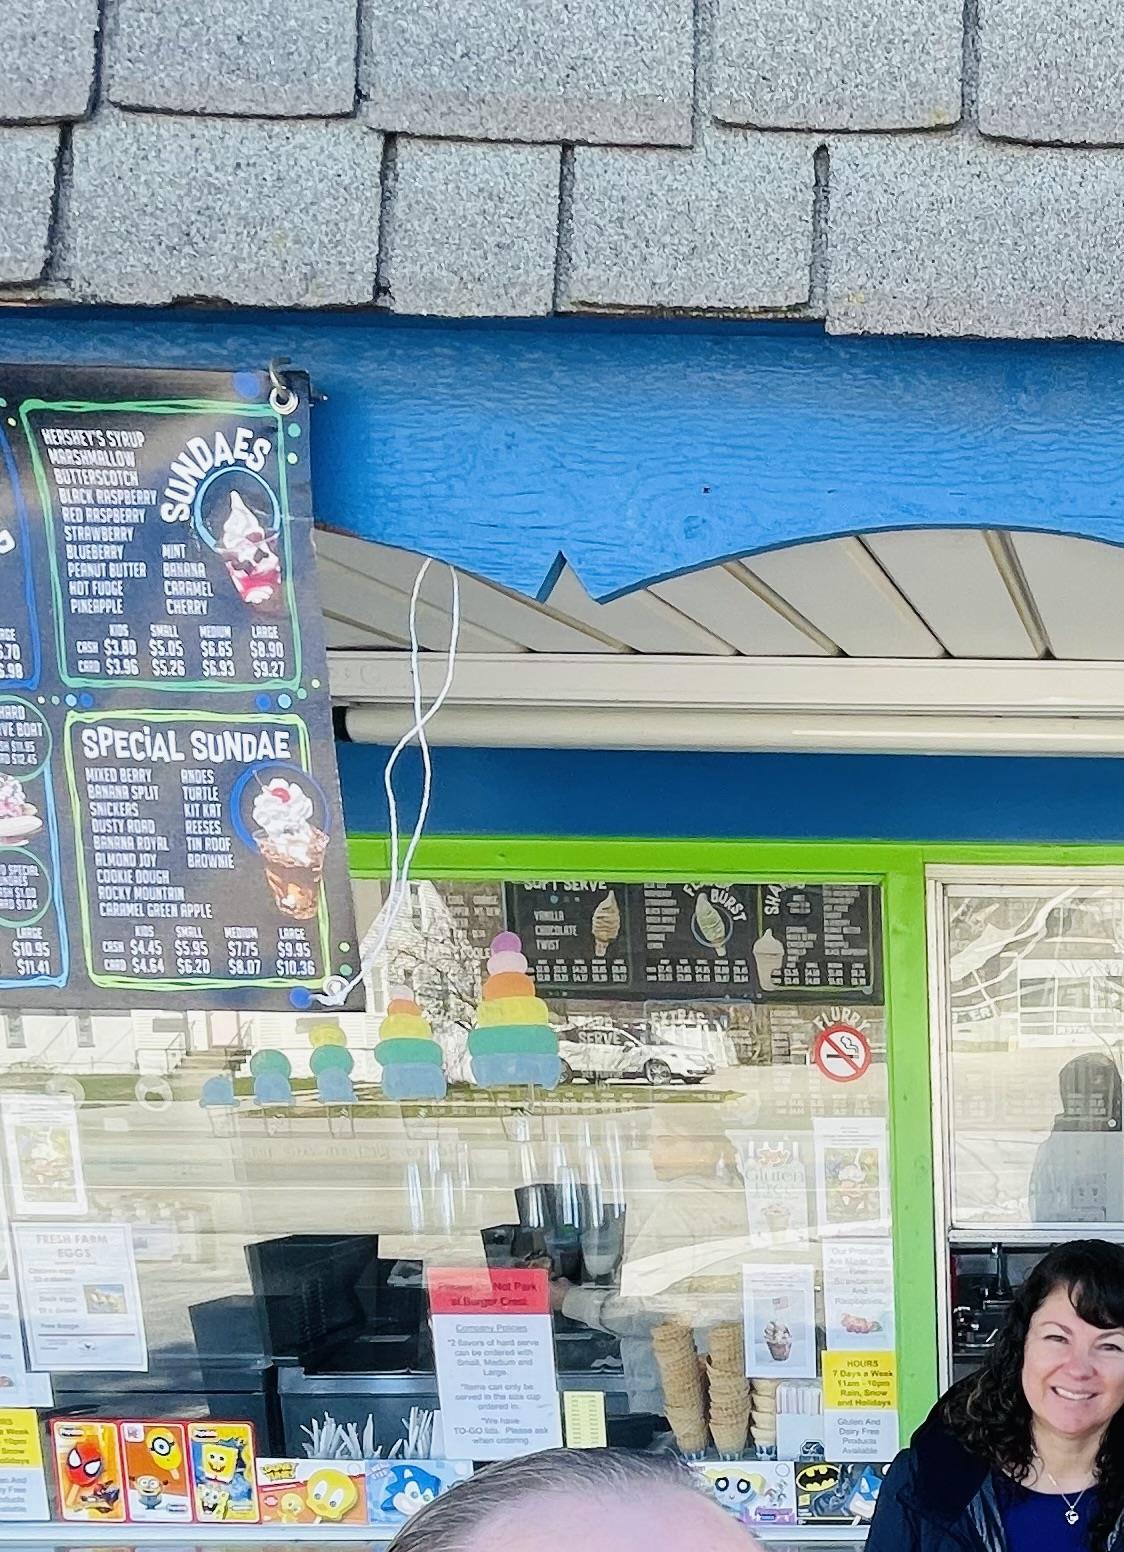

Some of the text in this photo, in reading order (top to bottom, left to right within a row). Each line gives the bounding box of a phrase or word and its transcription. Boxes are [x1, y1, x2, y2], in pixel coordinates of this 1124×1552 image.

[41, 428, 145, 448] HERSHEY'S SYRUP
[48, 448, 135, 467] MARSHMALLOW
[54, 468, 139, 486] BUTTERSCOTCH
[160, 427, 272, 523] SUNDAES
[59, 488, 157, 506] BLACK RASPBERRY
[61, 506, 145, 524] RED RASPBERRY
[64, 526, 134, 542] STRAWBERRY
[66, 544, 125, 560] BLUEBERRY
[162, 543, 186, 559] MINT
[68, 562, 147, 578] PEANUT BUTTER
[163, 562, 206, 578] BANANA
[69, 580, 124, 596] HOT FUDGE
[164, 580, 214, 597] CARAMEL
[71, 599, 124, 614] PINEAPPLE
[166, 599, 208, 615] CHERRY
[150, 625, 179, 638] SMALL
[251, 626, 279, 639] LARGE
[149, 639, 184, 657] $5.05
[201, 641, 233, 658] $6.65
[250, 640, 285, 659] $8.90
[105, 658, 140, 676] $3.96
[152, 659, 186, 677] $5.26
[202, 659, 235, 677] $6.93
[253, 660, 285, 678] $9.27
[190, 730, 292, 764] SUNDAE
[85, 767, 153, 783] MIXED BERRY
[181, 769, 215, 784] ANDES
[87, 785, 160, 801] BANANA SPLIT
[182, 786, 219, 801] TURTLE
[89, 803, 140, 818] SNICKERS
[184, 804, 222, 818] KIT KAT
[91, 819, 156, 834] DUSTY ROAD
[185, 820, 222, 835] REESES
[93, 836, 170, 851] BANANA ROYAL
[186, 837, 232, 852] TIN ROOF
[94, 853, 158, 868] ALMOND JOY
[187, 854, 235, 869] BROWNIE
[96, 869, 170, 885] COOKIE DOUGH
[98, 886, 185, 901] ROCKY MOUNTAIN
[99, 902, 214, 919] CARAMEL GREEN APPLE
[175, 926, 204, 939] SMALL
[12, 940, 51, 958] $10.95
[130, 939, 163, 956] $4.45
[175, 940, 209, 957] $5.95
[228, 941, 259, 957] $7.75
[277, 942, 312, 958] $9.95
[16, 958, 51, 976] $11.41
[132, 958, 165, 974] $4.64
[177, 958, 211, 975] $6.20
[228, 959, 261, 976] $8.07
[276, 960, 316, 976] $10.36
[578, 1031, 622, 1045] SERVE
[36, 1234, 71, 1245] FRESH
[58, 1248, 92, 1258] EGGS
[493, 1282, 511, 1291] Not
[514, 1282, 537, 1292] Park
[847, 1360, 879, 1368] HOURS
[840, 1370, 861, 1379] Days
[855, 1400, 891, 1409] Holidays
